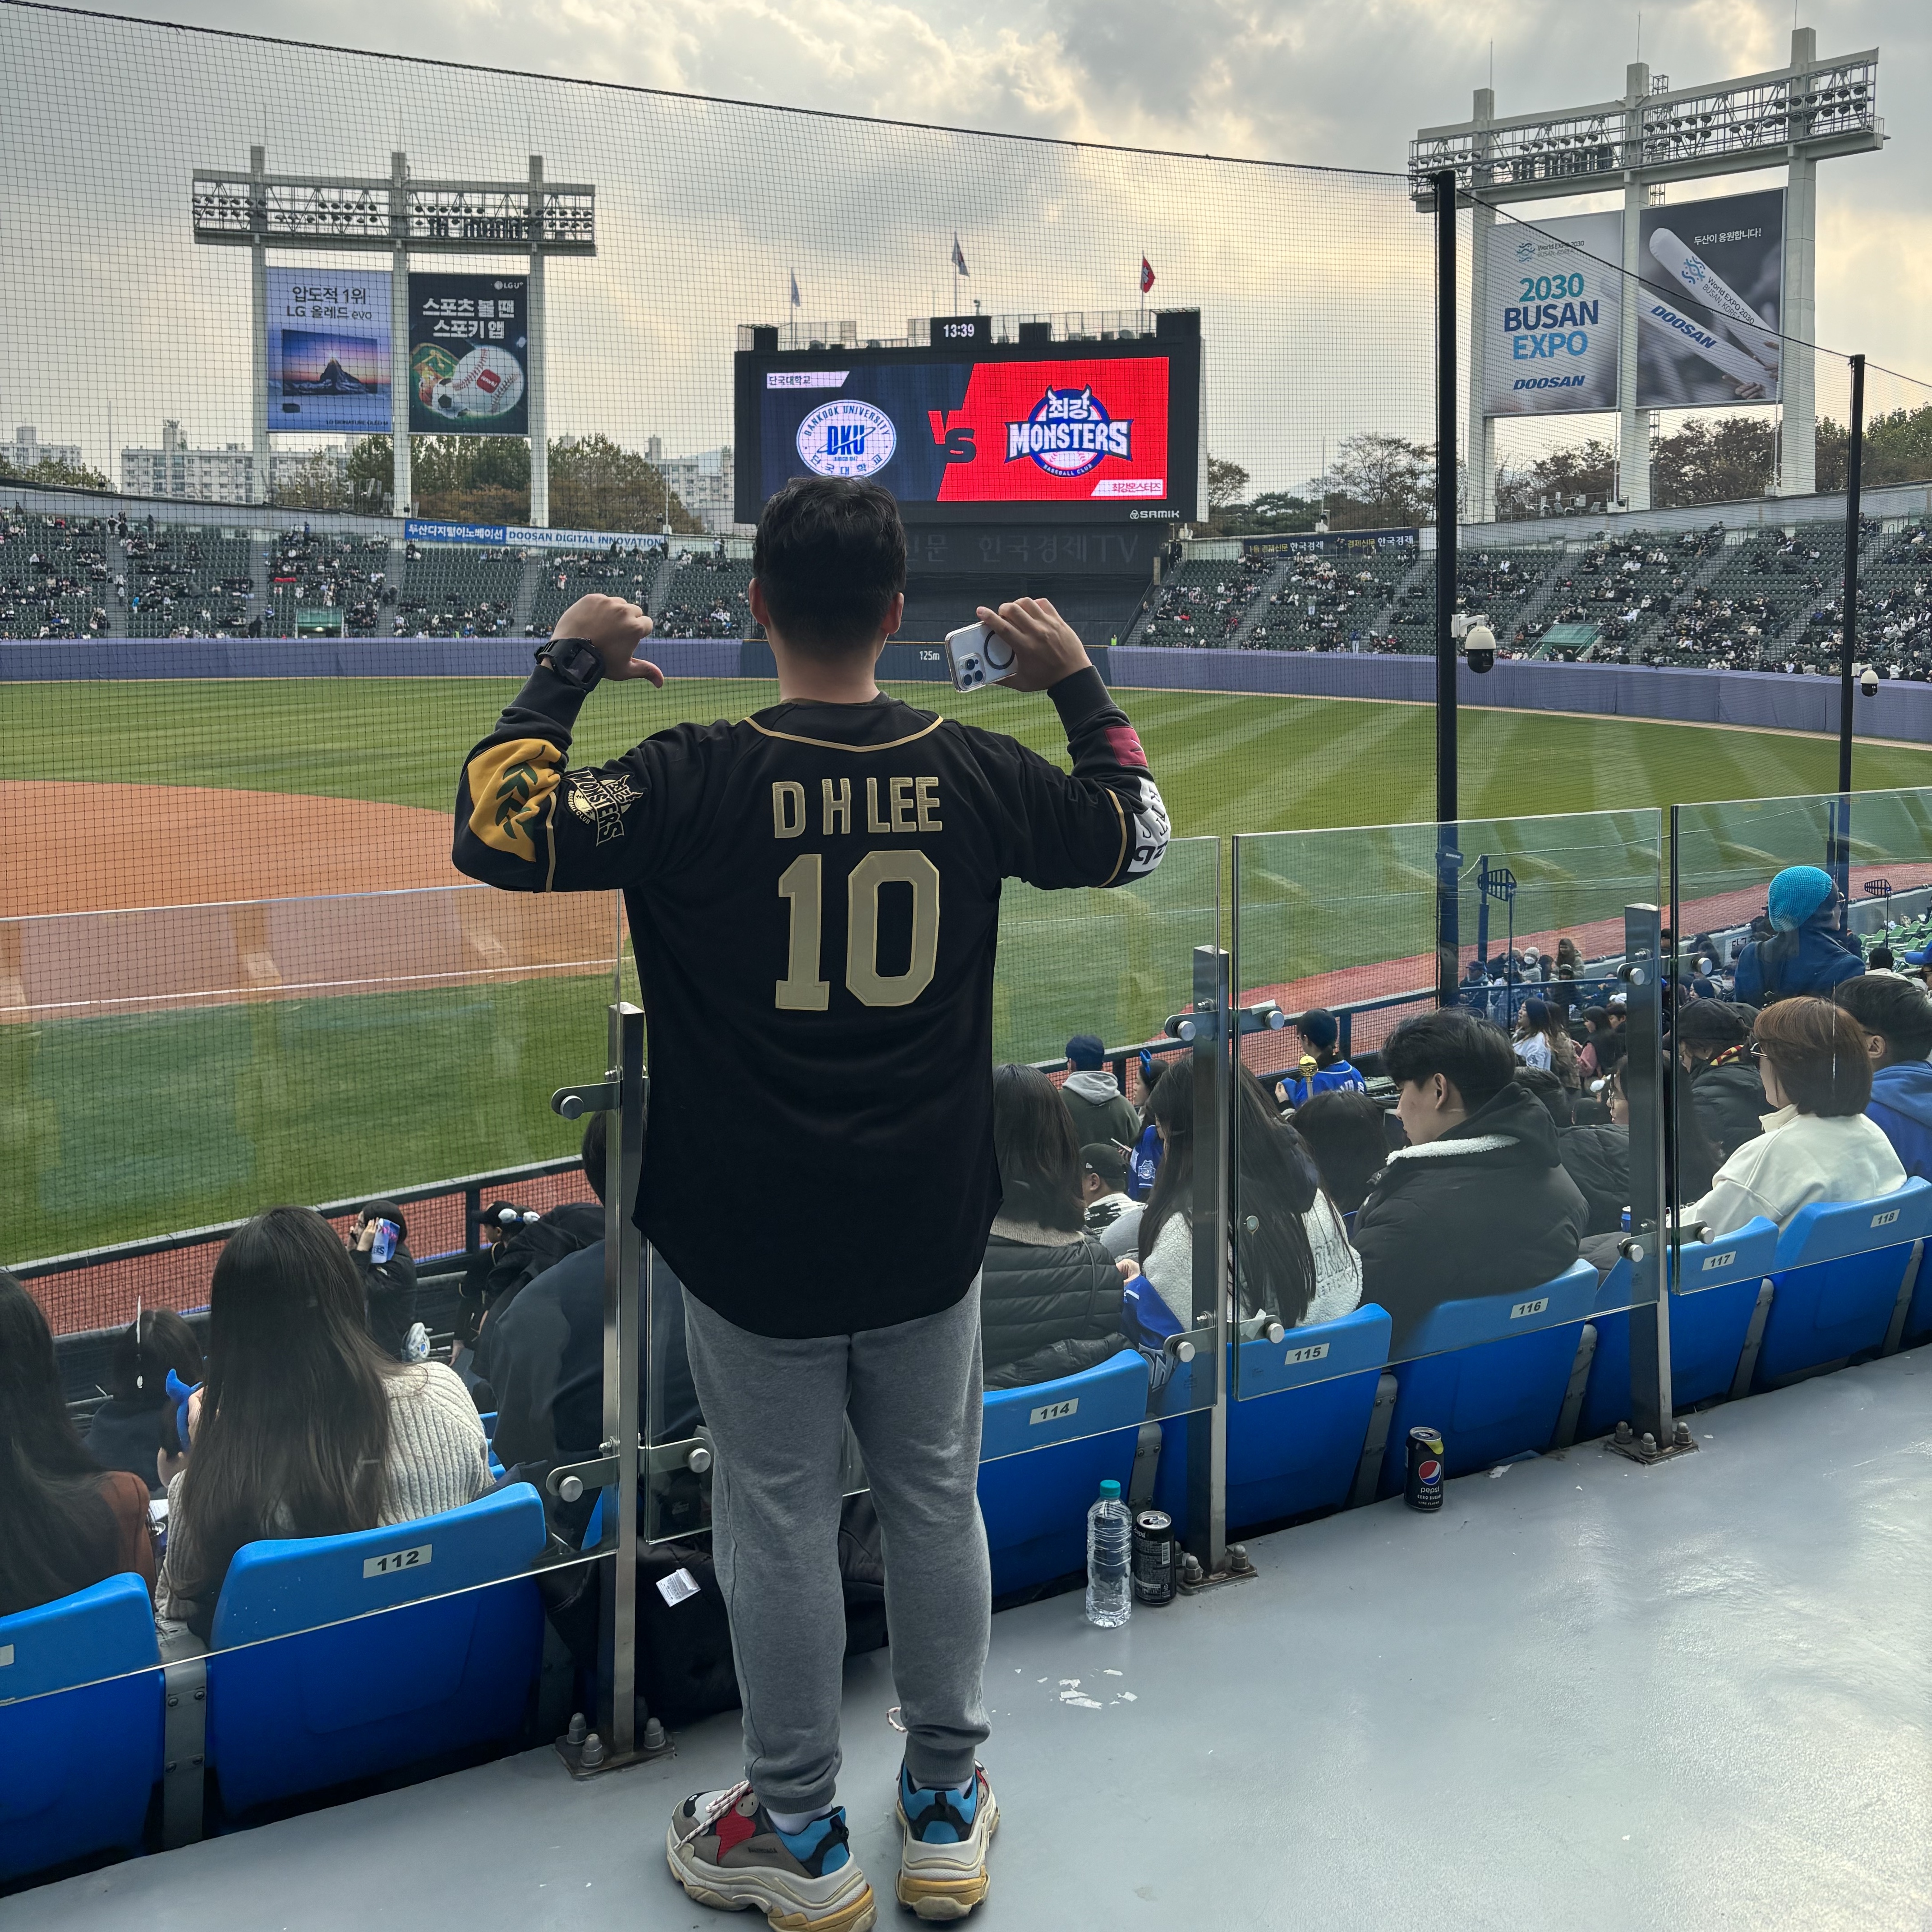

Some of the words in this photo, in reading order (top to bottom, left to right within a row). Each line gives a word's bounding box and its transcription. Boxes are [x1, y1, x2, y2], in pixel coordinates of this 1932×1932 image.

[1694, 234, 1717, 245] 두산이
[1719, 228, 1761, 243] 응원합니다!
[293, 285, 338, 304] 압도적
[343, 288, 366, 304] 1위
[1519, 272, 1584, 302] 2030
[423, 298, 475, 317] 스포츠
[478, 299, 494, 317] 볼
[1702, 284, 1723, 306] BUSAN,
[1721, 303, 1741, 320] KOREA
[1708, 276, 1725, 296] World
[1724, 294, 1741, 311] EXPO
[1739, 308, 1755, 325] 2030
[287, 305, 306, 317] LG
[310, 305, 350, 319] 올레드
[352, 311, 372, 320] evo
[1504, 300, 1598, 332] BUSAN
[433, 319, 485, 339] 스포키
[488, 321, 505, 339] 앱
[943, 324, 975, 337] 13:39
[1651, 305, 1717, 349] DOOSAN
[1513, 330, 1588, 360] EXPO
[769, 376, 811, 386] 단국대학교
[1513, 375, 1586, 390] DOOSAN
[1049, 397, 1090, 419] 최강
[843, 406, 890, 436] UNIVERSITY
[827, 425, 865, 455] DKU
[928, 410, 977, 463] VS
[1009, 421, 1128, 458] MONSTERS
[1043, 464, 1075, 476] BASEBALL
[1076, 464, 1093, 474] CLUB
[1112, 483, 1161, 493] 최강몬스터즈
[1139, 510, 1180, 519] SAMIK
[408, 524, 503, 540] 두산디지털이노베이션
[509, 531, 552, 542] DOOSAN
[555, 534, 595, 543] DIGITAL
[598, 536, 661, 547] INNOVATION
[919, 650, 940, 660] 125m
[565, 770, 624, 844] MONSTERS
[772, 781, 806, 838] D
[821, 777, 851, 835] H
[866, 777, 943, 833] LEE
[576, 811, 590, 824] CLUB
[775, 849, 940, 1011] 10
[1878, 1212, 1895, 1224] 118
[1711, 1254, 1730, 1267] 117
[1519, 1301, 1541, 1315] 116
[1295, 1347, 1321, 1361] 115
[1040, 1403, 1070, 1419] 114
[1420, 1486, 1439, 1494] pepsi
[377, 1550, 419, 1572] 112
